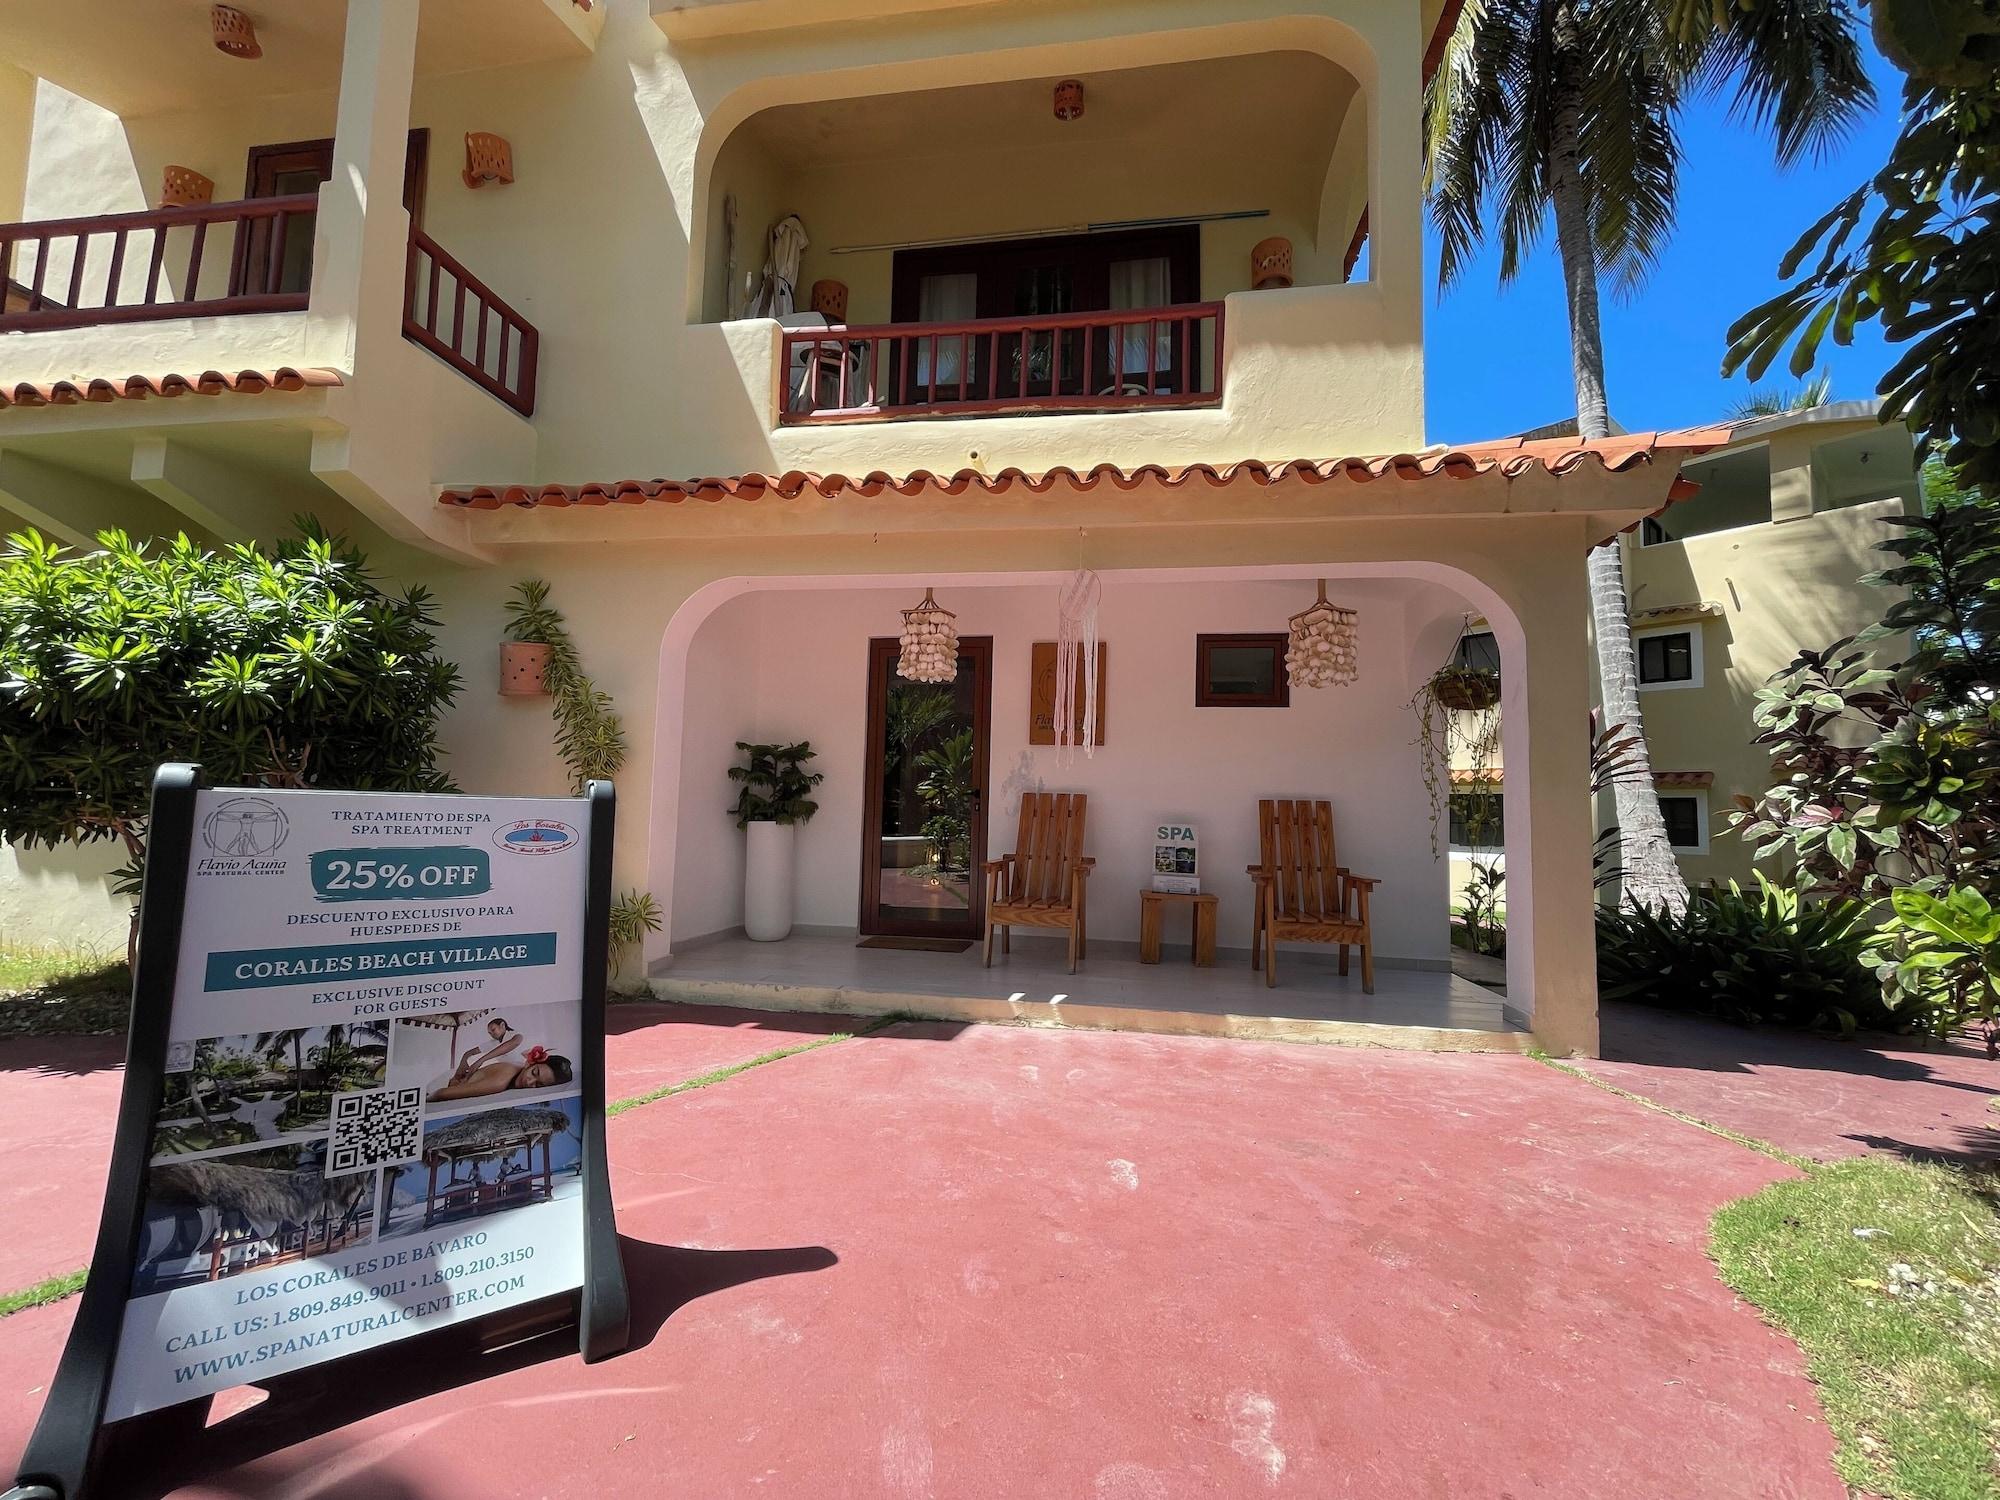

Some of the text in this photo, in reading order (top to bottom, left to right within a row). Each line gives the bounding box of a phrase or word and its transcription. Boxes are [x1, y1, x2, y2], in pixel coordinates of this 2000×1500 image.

[331, 810, 491, 823] TRATAMIENTO DE SPA
[351, 825, 473, 835] SPA TREATMENT
[1157, 826, 1195, 841] SPA
[198, 858, 241, 870] Flavio
[326, 860, 479, 890] 25% OFF
[287, 905, 515, 925] DESCUENTO EXCLUSIVO PARA
[350, 921, 462, 937] HUESPEDES DE
[234, 944, 528, 980] CORALES BEACH VILLAGE
[312, 979, 486, 1004] EXCLUSIVE DISCOUNT
[353, 996, 448, 1015] FOR GUESTS
[234, 1231, 488, 1305] LOS CORALES DE BÁVARO
[165, 1246, 535, 1353] CALL US: 1.809.849.9011 1.809.210.3150
[173, 1274, 526, 1384] WWW.SPANATURALCENTER.COM
